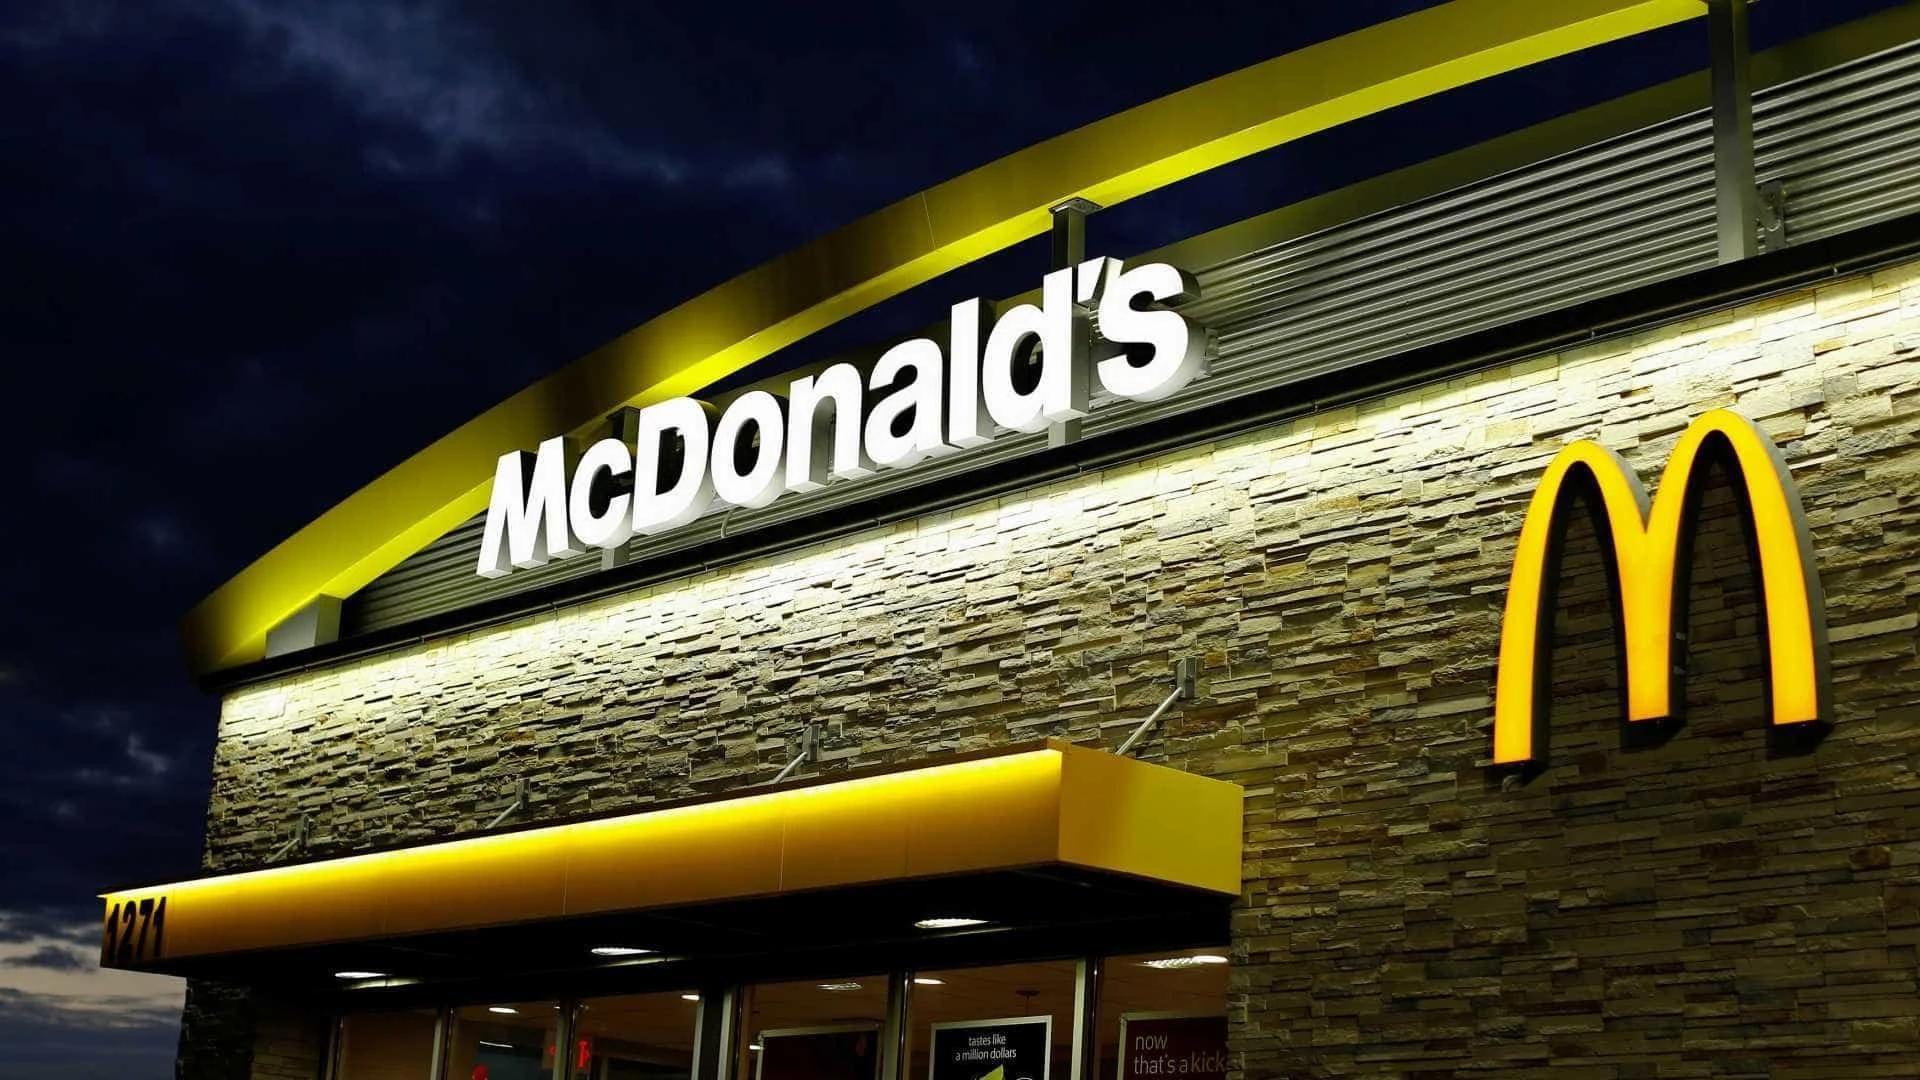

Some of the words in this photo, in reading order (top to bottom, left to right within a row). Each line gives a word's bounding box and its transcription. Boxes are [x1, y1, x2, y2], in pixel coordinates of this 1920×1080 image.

[476, 256, 1203, 578] McDonald's
[106, 896, 167, 961] 1271
[968, 1035, 991, 1047] tastes
[992, 1033, 1007, 1046] like
[1135, 1032, 1168, 1051] now
[955, 1052, 961, 1061] a
[962, 1048, 989, 1062] million
[990, 1047, 1017, 1060] dollars
[1134, 1053, 1176, 1075] that's
[1179, 1058, 1188, 1074] a
